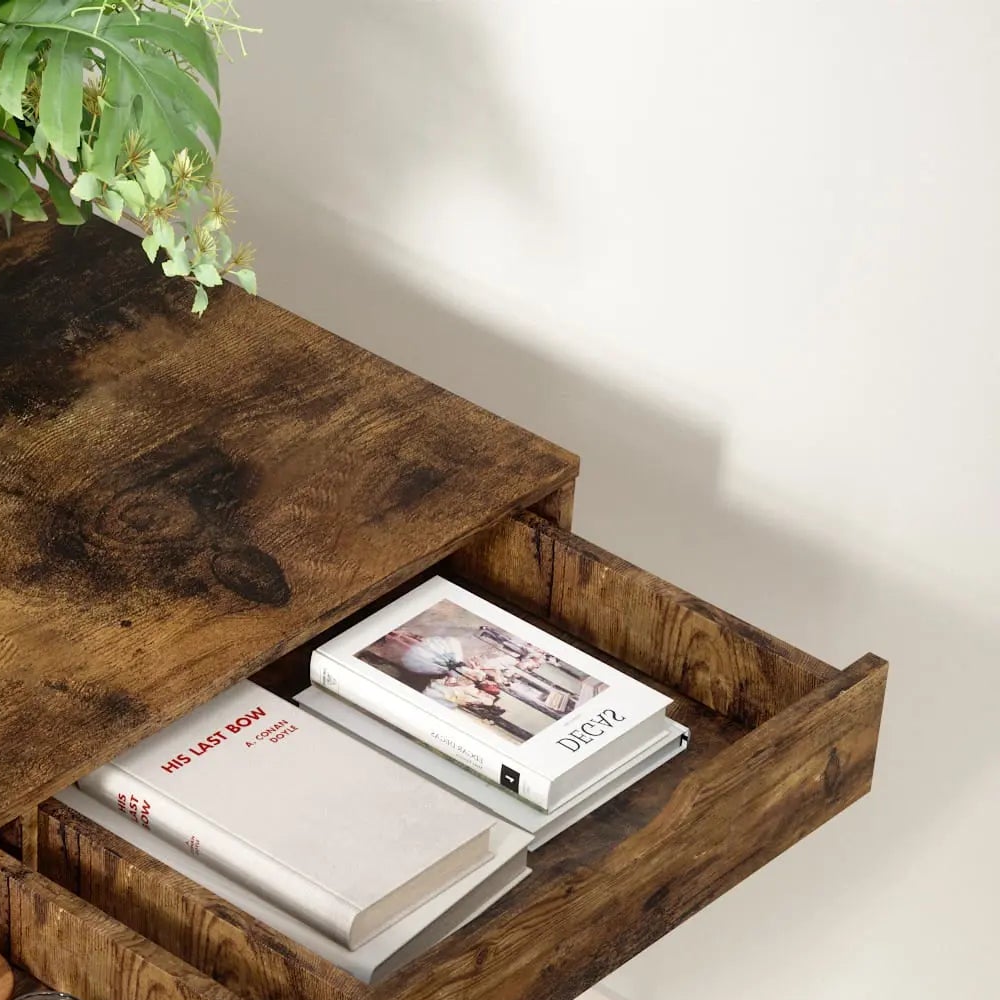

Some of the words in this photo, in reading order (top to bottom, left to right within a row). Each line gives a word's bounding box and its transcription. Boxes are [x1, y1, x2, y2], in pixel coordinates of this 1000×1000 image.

[161, 753, 192, 774] HIS
[189, 731, 228, 757] LAST
[225, 706, 267, 735] BOW
[255, 719, 289, 741] CONAN
[269, 724, 299, 744] DOYLE
[117, 793, 127, 814] HIS
